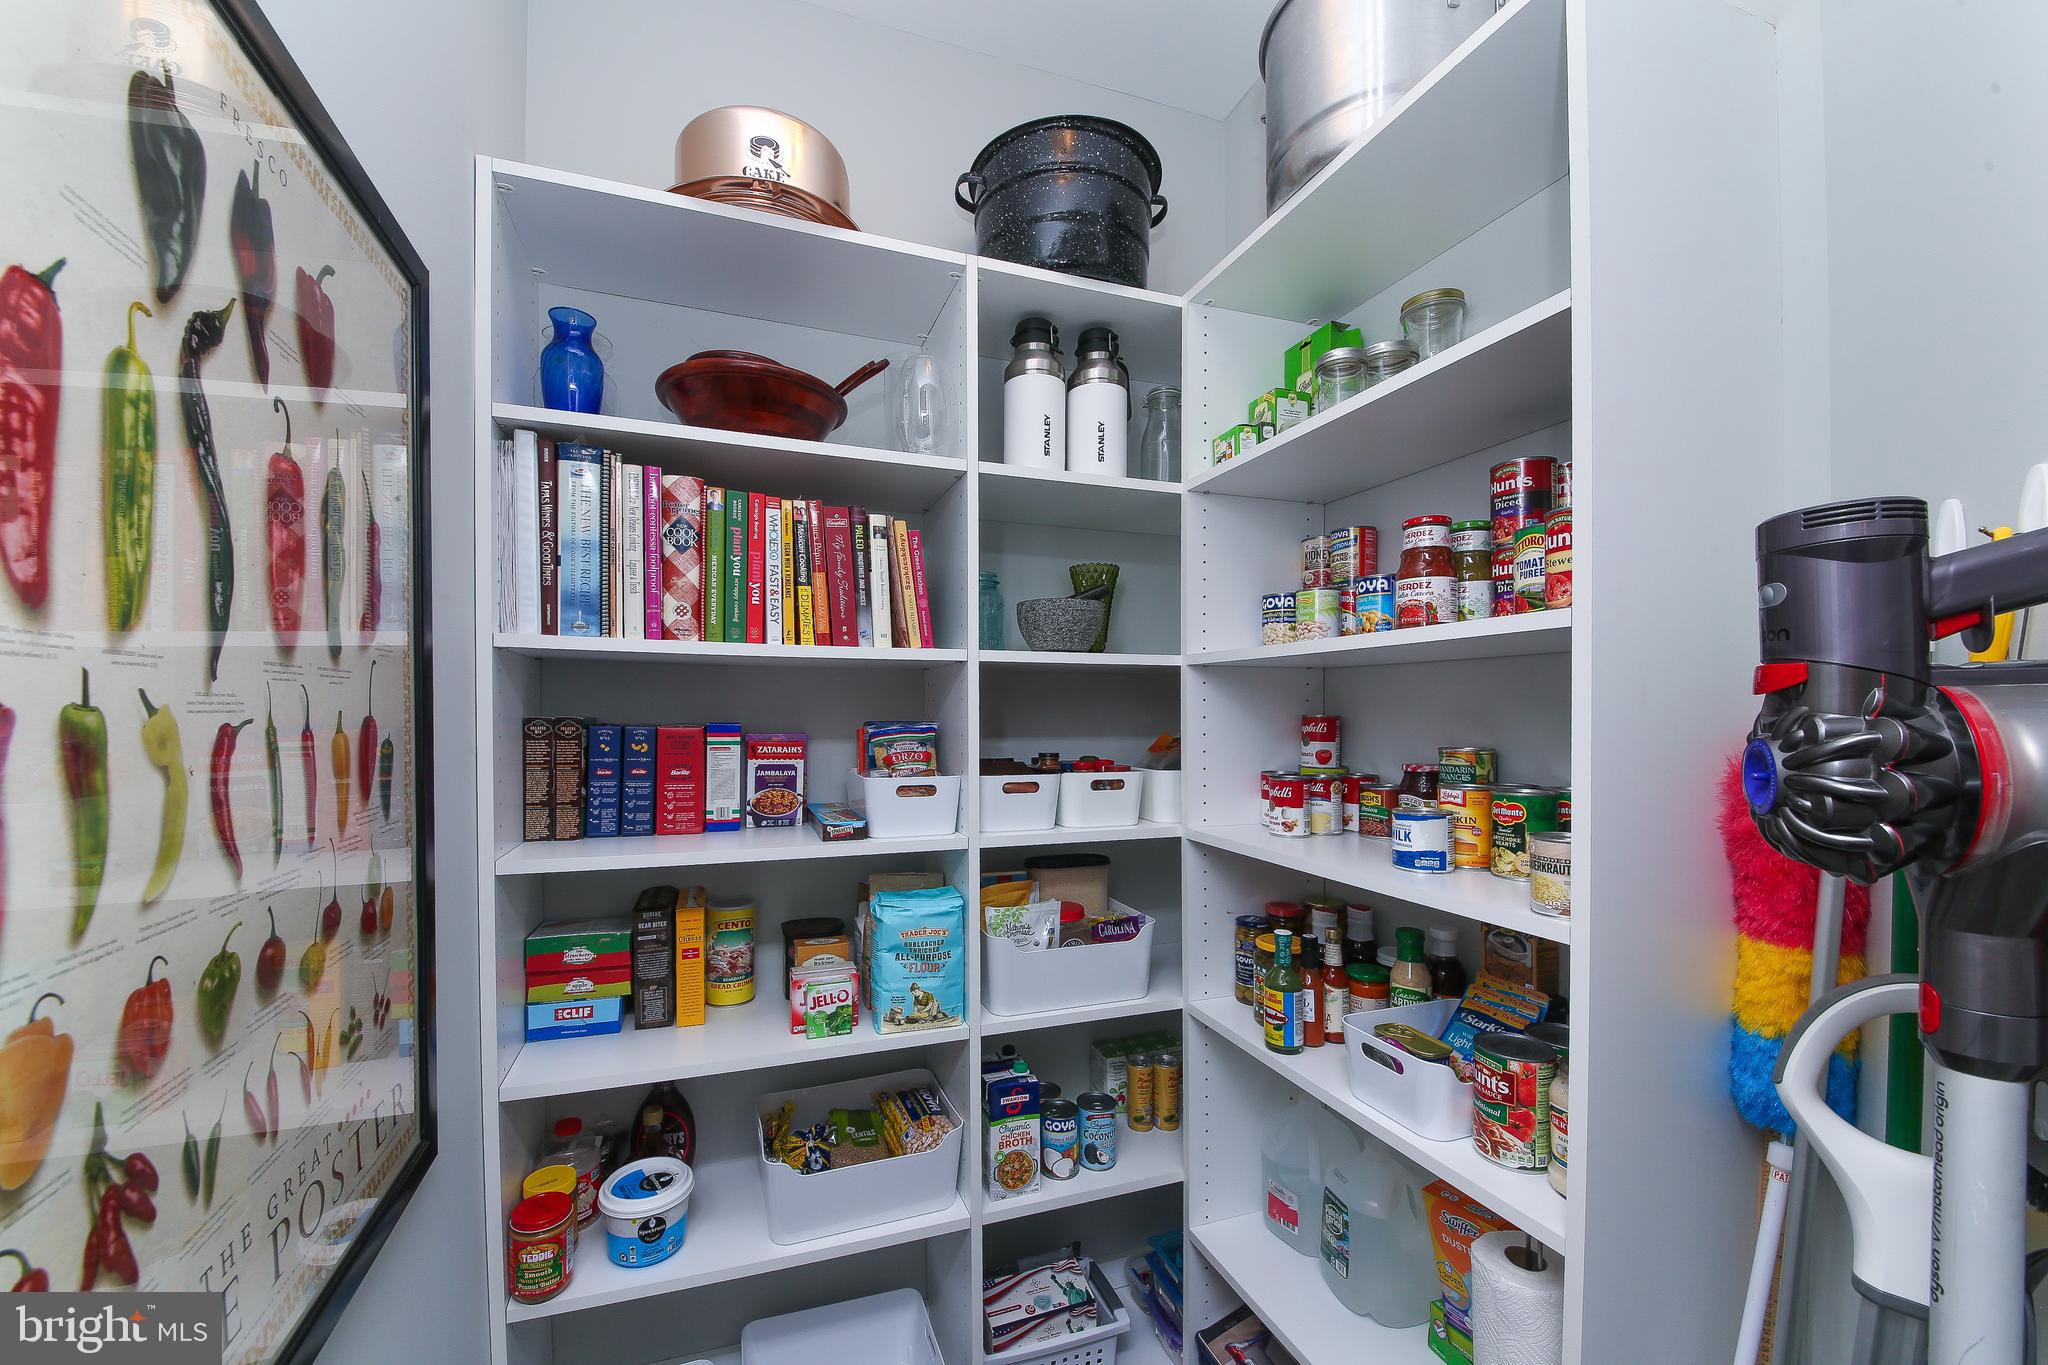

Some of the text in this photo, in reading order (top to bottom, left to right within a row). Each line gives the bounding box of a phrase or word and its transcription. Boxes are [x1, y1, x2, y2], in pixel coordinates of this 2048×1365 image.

[216, 90, 289, 188] FRESCO
[742, 165, 785, 183] CAKE
[1043, 413, 1051, 457] STANLEY
[1097, 421, 1105, 462] STANLEY
[1495, 499, 1522, 511] Diced
[648, 511, 659, 549] contessa
[667, 528, 698, 538] COOK
[667, 537, 698, 548] BOOK
[768, 514, 780, 562] WHOLE30
[855, 525, 865, 549] PALEO
[580, 538, 591, 564] BEST
[796, 523, 807, 583] Mexican Cooking
[1304, 549, 1331, 560] KIDNEY
[913, 550, 922, 570] Green
[1516, 557, 1544, 572] TOMAT
[1546, 556, 1572, 568] Stewe
[647, 553, 660, 594] foolproof
[1519, 568, 1545, 580] PUREE
[580, 568, 592, 607] RECIPE
[916, 571, 924, 595] Kitchen
[1397, 582, 1432, 592] HERDEZ
[1497, 585, 1513, 593] Dic
[710, 589, 718, 625] EVERYDAY
[800, 594, 812, 635] DUMMIES
[892, 752, 924, 762] ORZO
[1500, 806, 1523, 817] Monte
[1393, 829, 1412, 843] ILK
[1530, 853, 1571, 864] REDDED
[1531, 860, 1571, 876] ERKRAUT
[638, 920, 667, 929] BEAR BITES
[717, 919, 752, 930] CENTO
[1005, 921, 1033, 933] Nature's
[1099, 922, 1137, 937] CAROLINA
[900, 929, 927, 938] TRADER
[903, 939, 945, 948] UNBLEACHED
[895, 950, 952, 962] ALL-PURPOSE
[908, 961, 941, 974] FLOUR
[711, 979, 753, 989] BREAD CRUMB
[562, 1007, 592, 1018] CLIF
[1464, 1014, 1506, 1032] StarKi
[1448, 1033, 1472, 1049] Light
[1001, 1095, 1028, 1104] SWANSON
[998, 1122, 1032, 1135] Organic
[1045, 1120, 1076, 1131] GOYA
[851, 1128, 876, 1139] LENTILS
[1000, 1131, 1031, 1140] CHICKEN
[998, 1136, 1033, 1150] BROTH
[267, 1082, 406, 1287] POSTER
[1929, 1081, 1949, 1303] dyson motorhead origin
[200, 1223, 252, 1293] THE
[268, 1132, 333, 1220] GREAT
[638, 1224, 666, 1236] Spectrum
[1439, 1210, 1479, 1239] Swiffer
[521, 1249, 554, 1263] TEDDIE
[524, 1268, 553, 1279] Smooth
